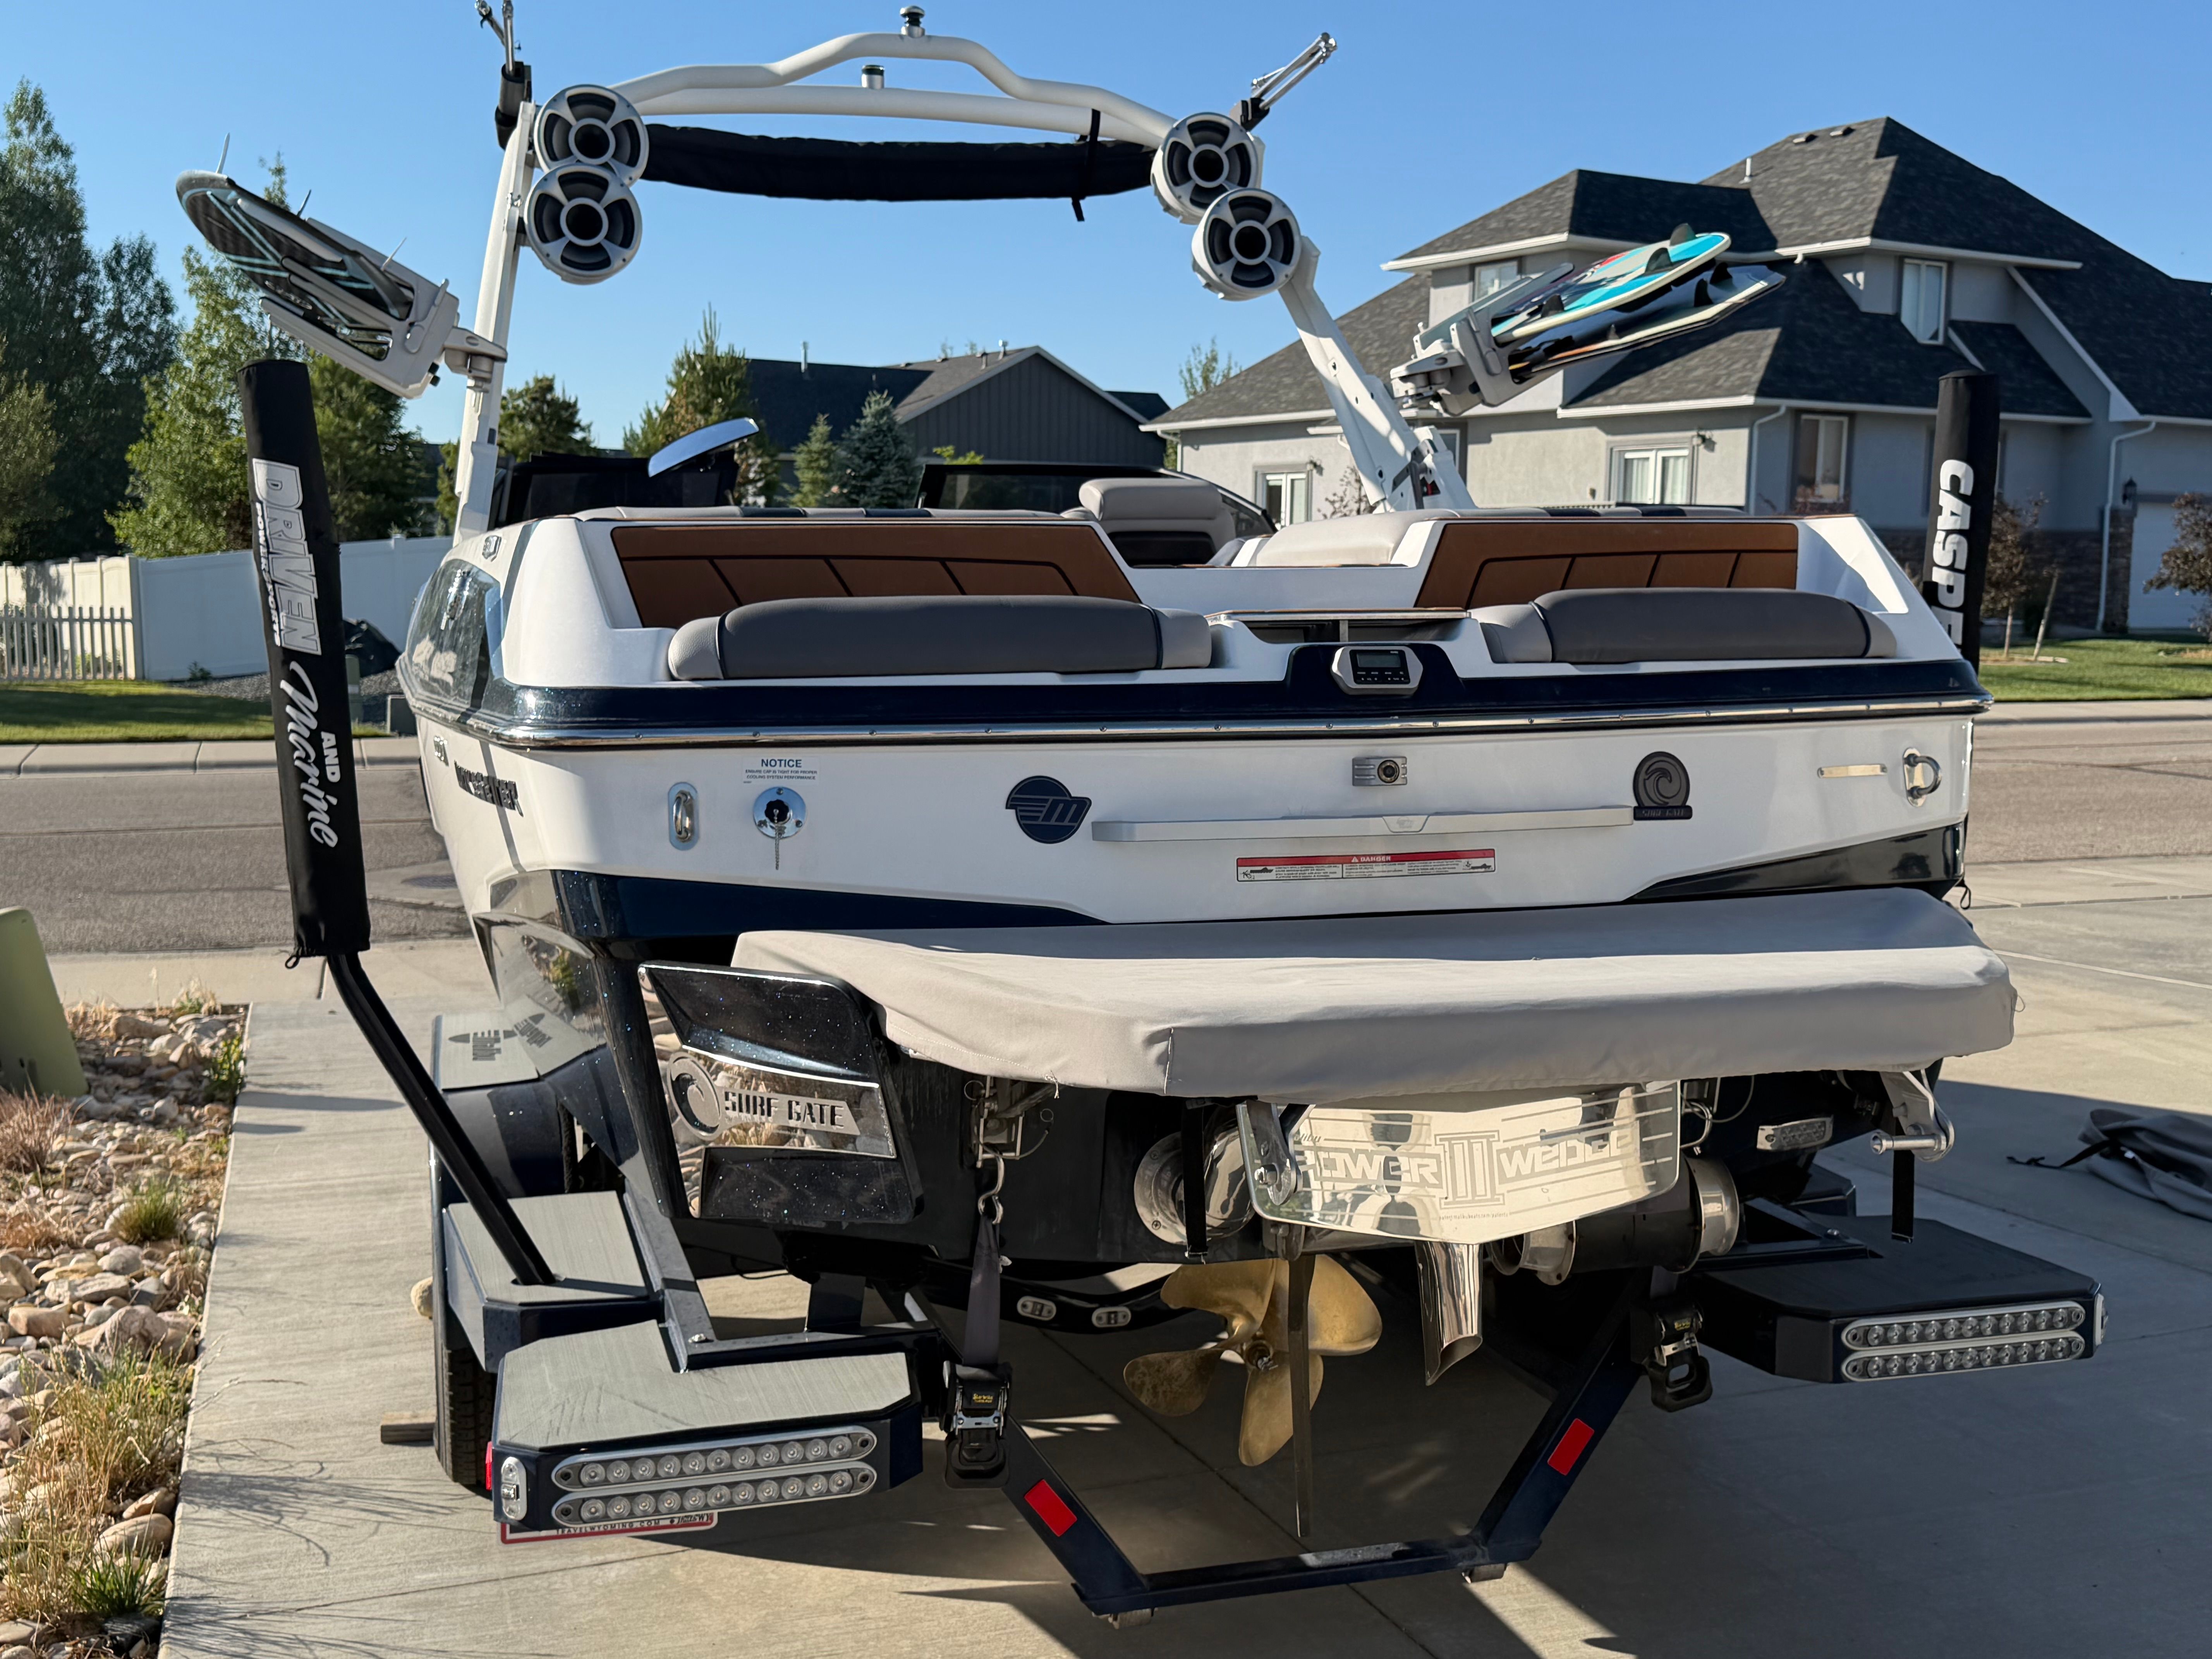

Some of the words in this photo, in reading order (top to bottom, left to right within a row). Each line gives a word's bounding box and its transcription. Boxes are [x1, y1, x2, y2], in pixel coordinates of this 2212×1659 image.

[252, 458, 321, 655] DRIVEN
[256, 502, 281, 647] POWERSPORTS
[1931, 459, 1973, 653] CASPE
[280, 661, 338, 848] Marine
[321, 731, 341, 783] AND
[761, 759, 802, 768] NOTICE
[725, 1091, 779, 1117] SURF
[788, 1100, 845, 1127] GATE
[556, 1520, 661, 1535] TRAVELWYOMING.COM
